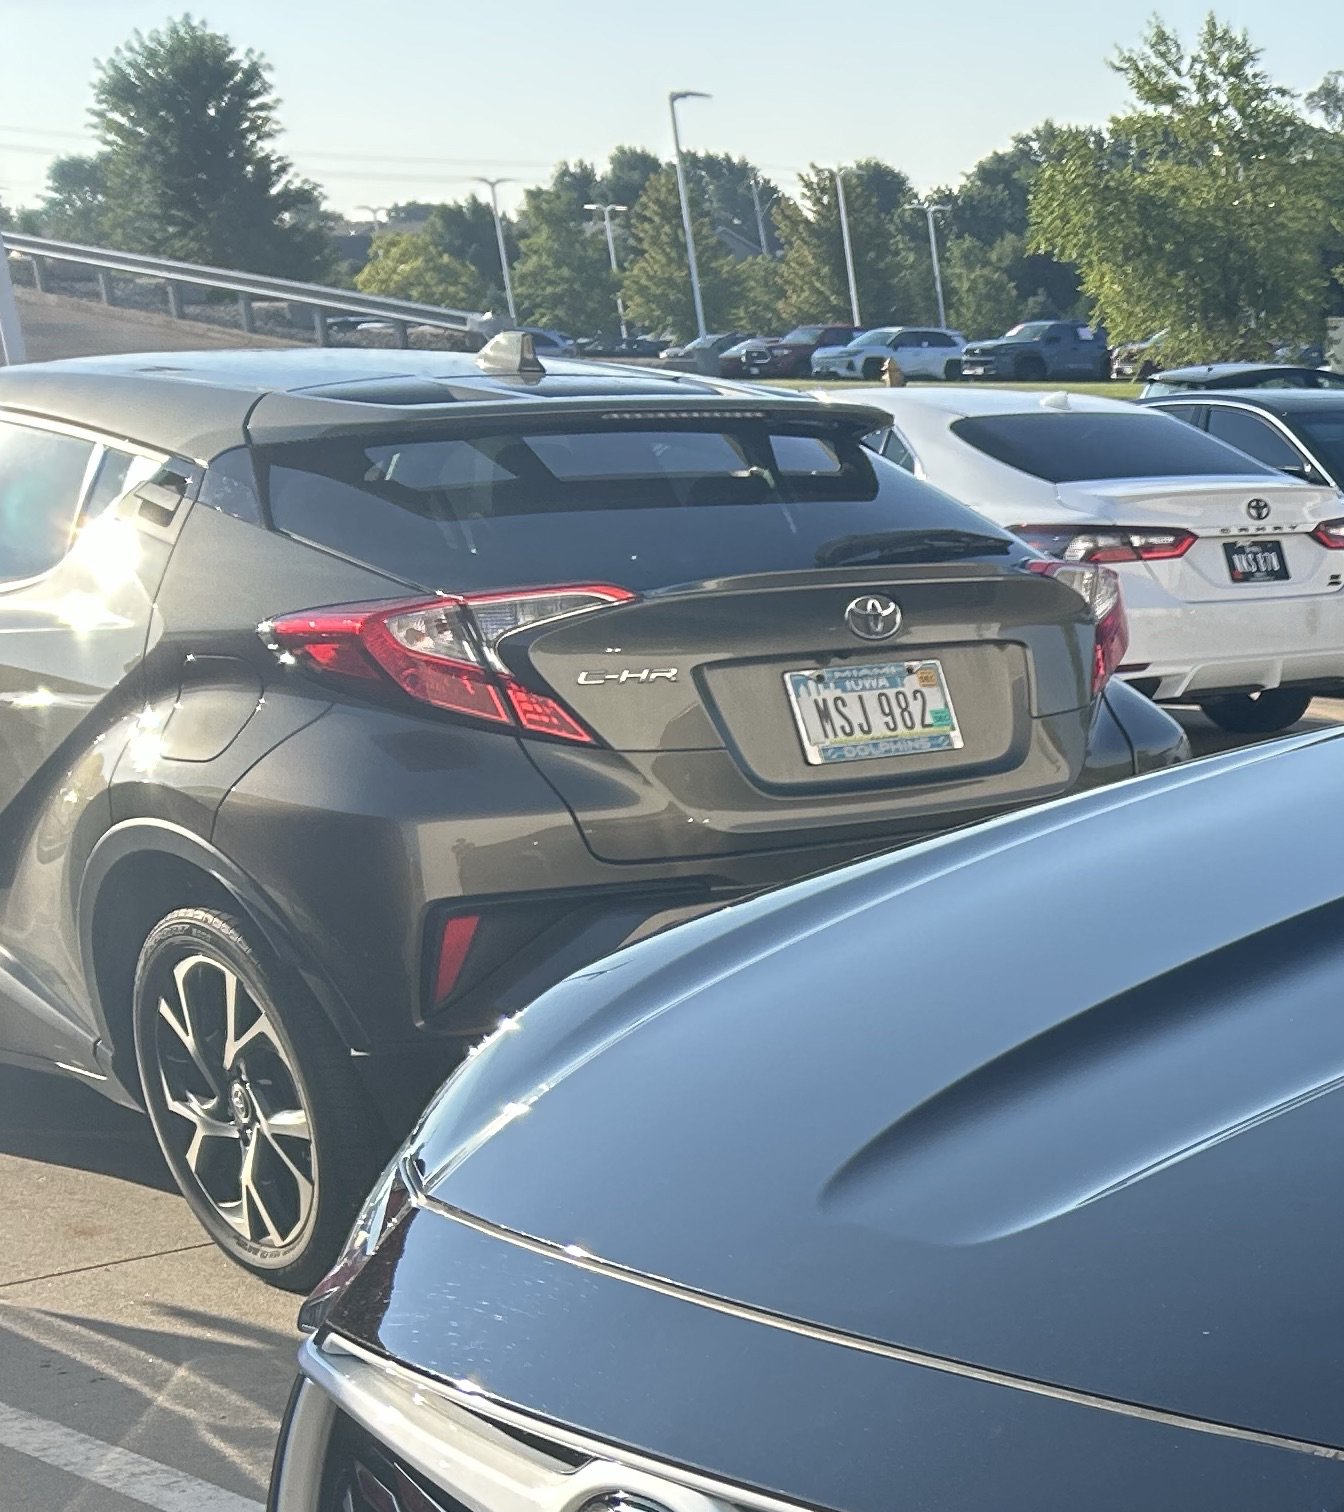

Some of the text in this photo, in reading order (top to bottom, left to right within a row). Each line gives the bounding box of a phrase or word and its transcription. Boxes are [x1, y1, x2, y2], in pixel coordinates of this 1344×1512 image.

[577, 668, 678, 685] C-HR
[845, 679, 889, 691] IOWA
[814, 689, 934, 739] MSJ 982
